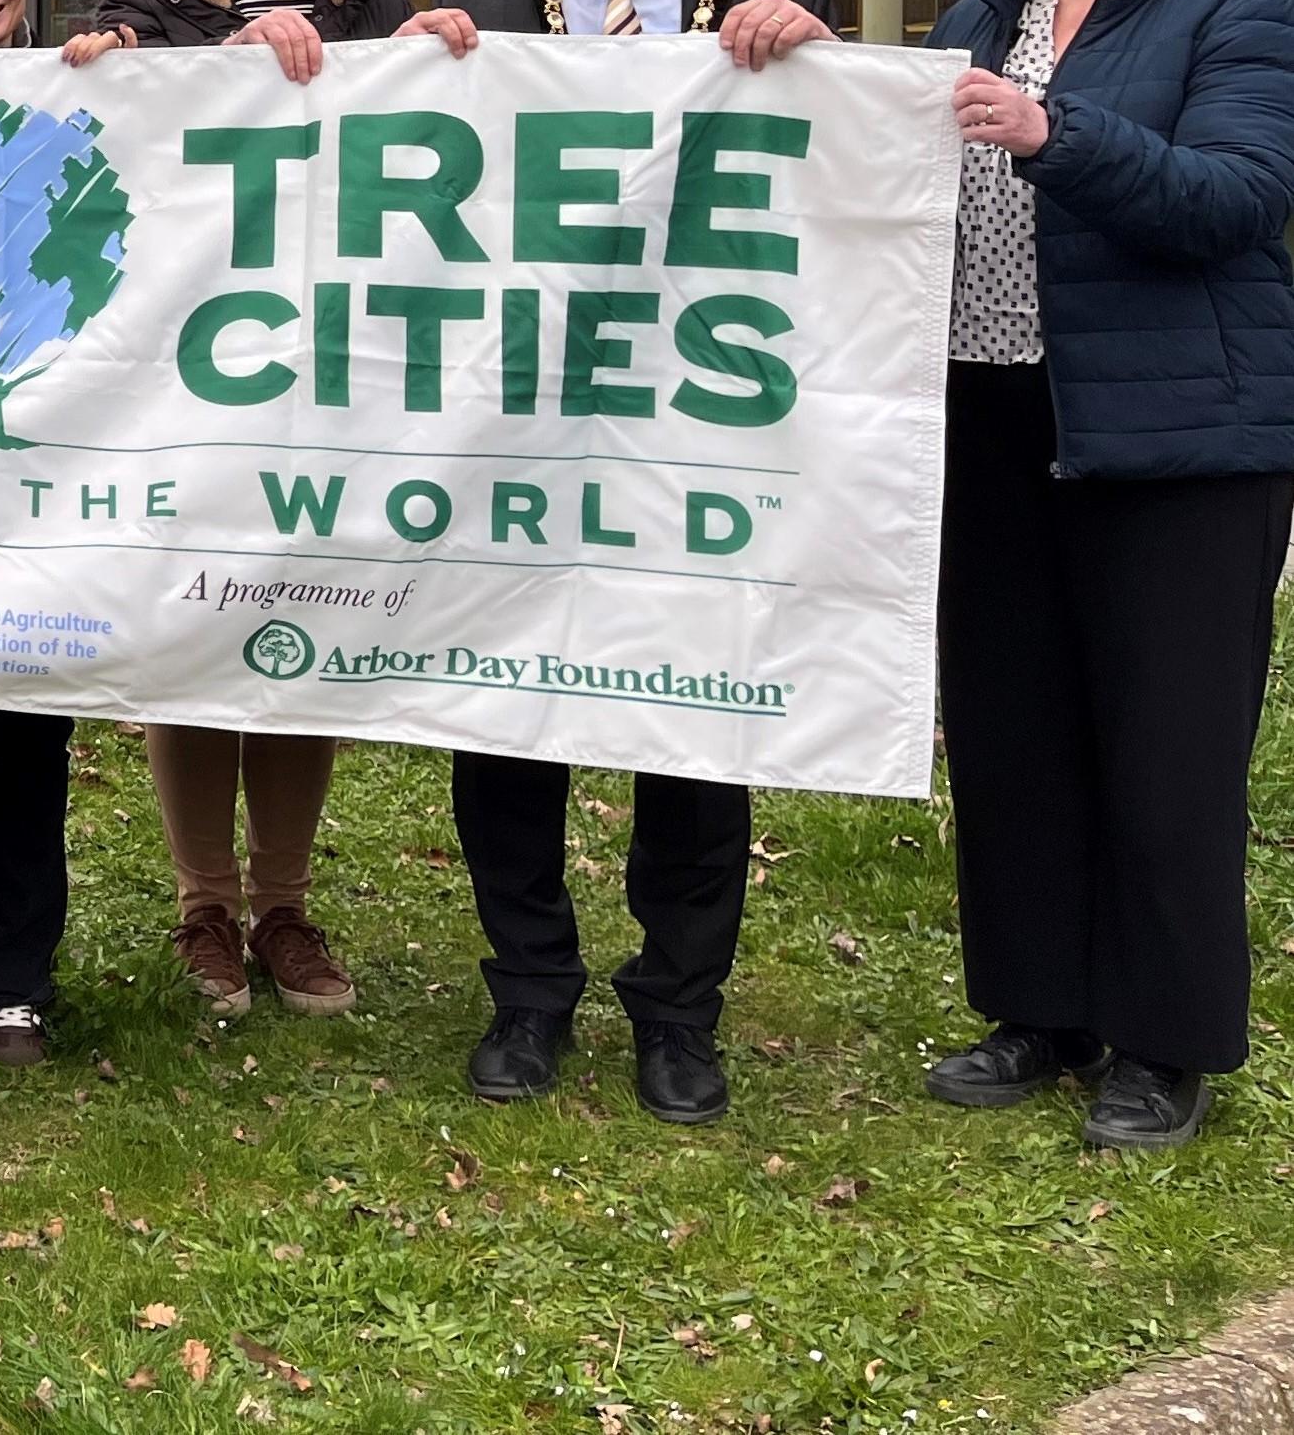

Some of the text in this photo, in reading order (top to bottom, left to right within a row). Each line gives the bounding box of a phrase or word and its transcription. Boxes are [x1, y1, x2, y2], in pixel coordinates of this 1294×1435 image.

[183, 111, 810, 275] TREE
[178, 282, 797, 427] CITIES
[20, 479, 177, 519] THE
[181, 570, 208, 601] A
[216, 577, 375, 611] programme
[1, 608, 112, 635] Agriculture
[39, 638, 60, 656] of
[65, 640, 97, 659] the
[319, 645, 435, 675] Arbor
[444, 647, 530, 689] Day
